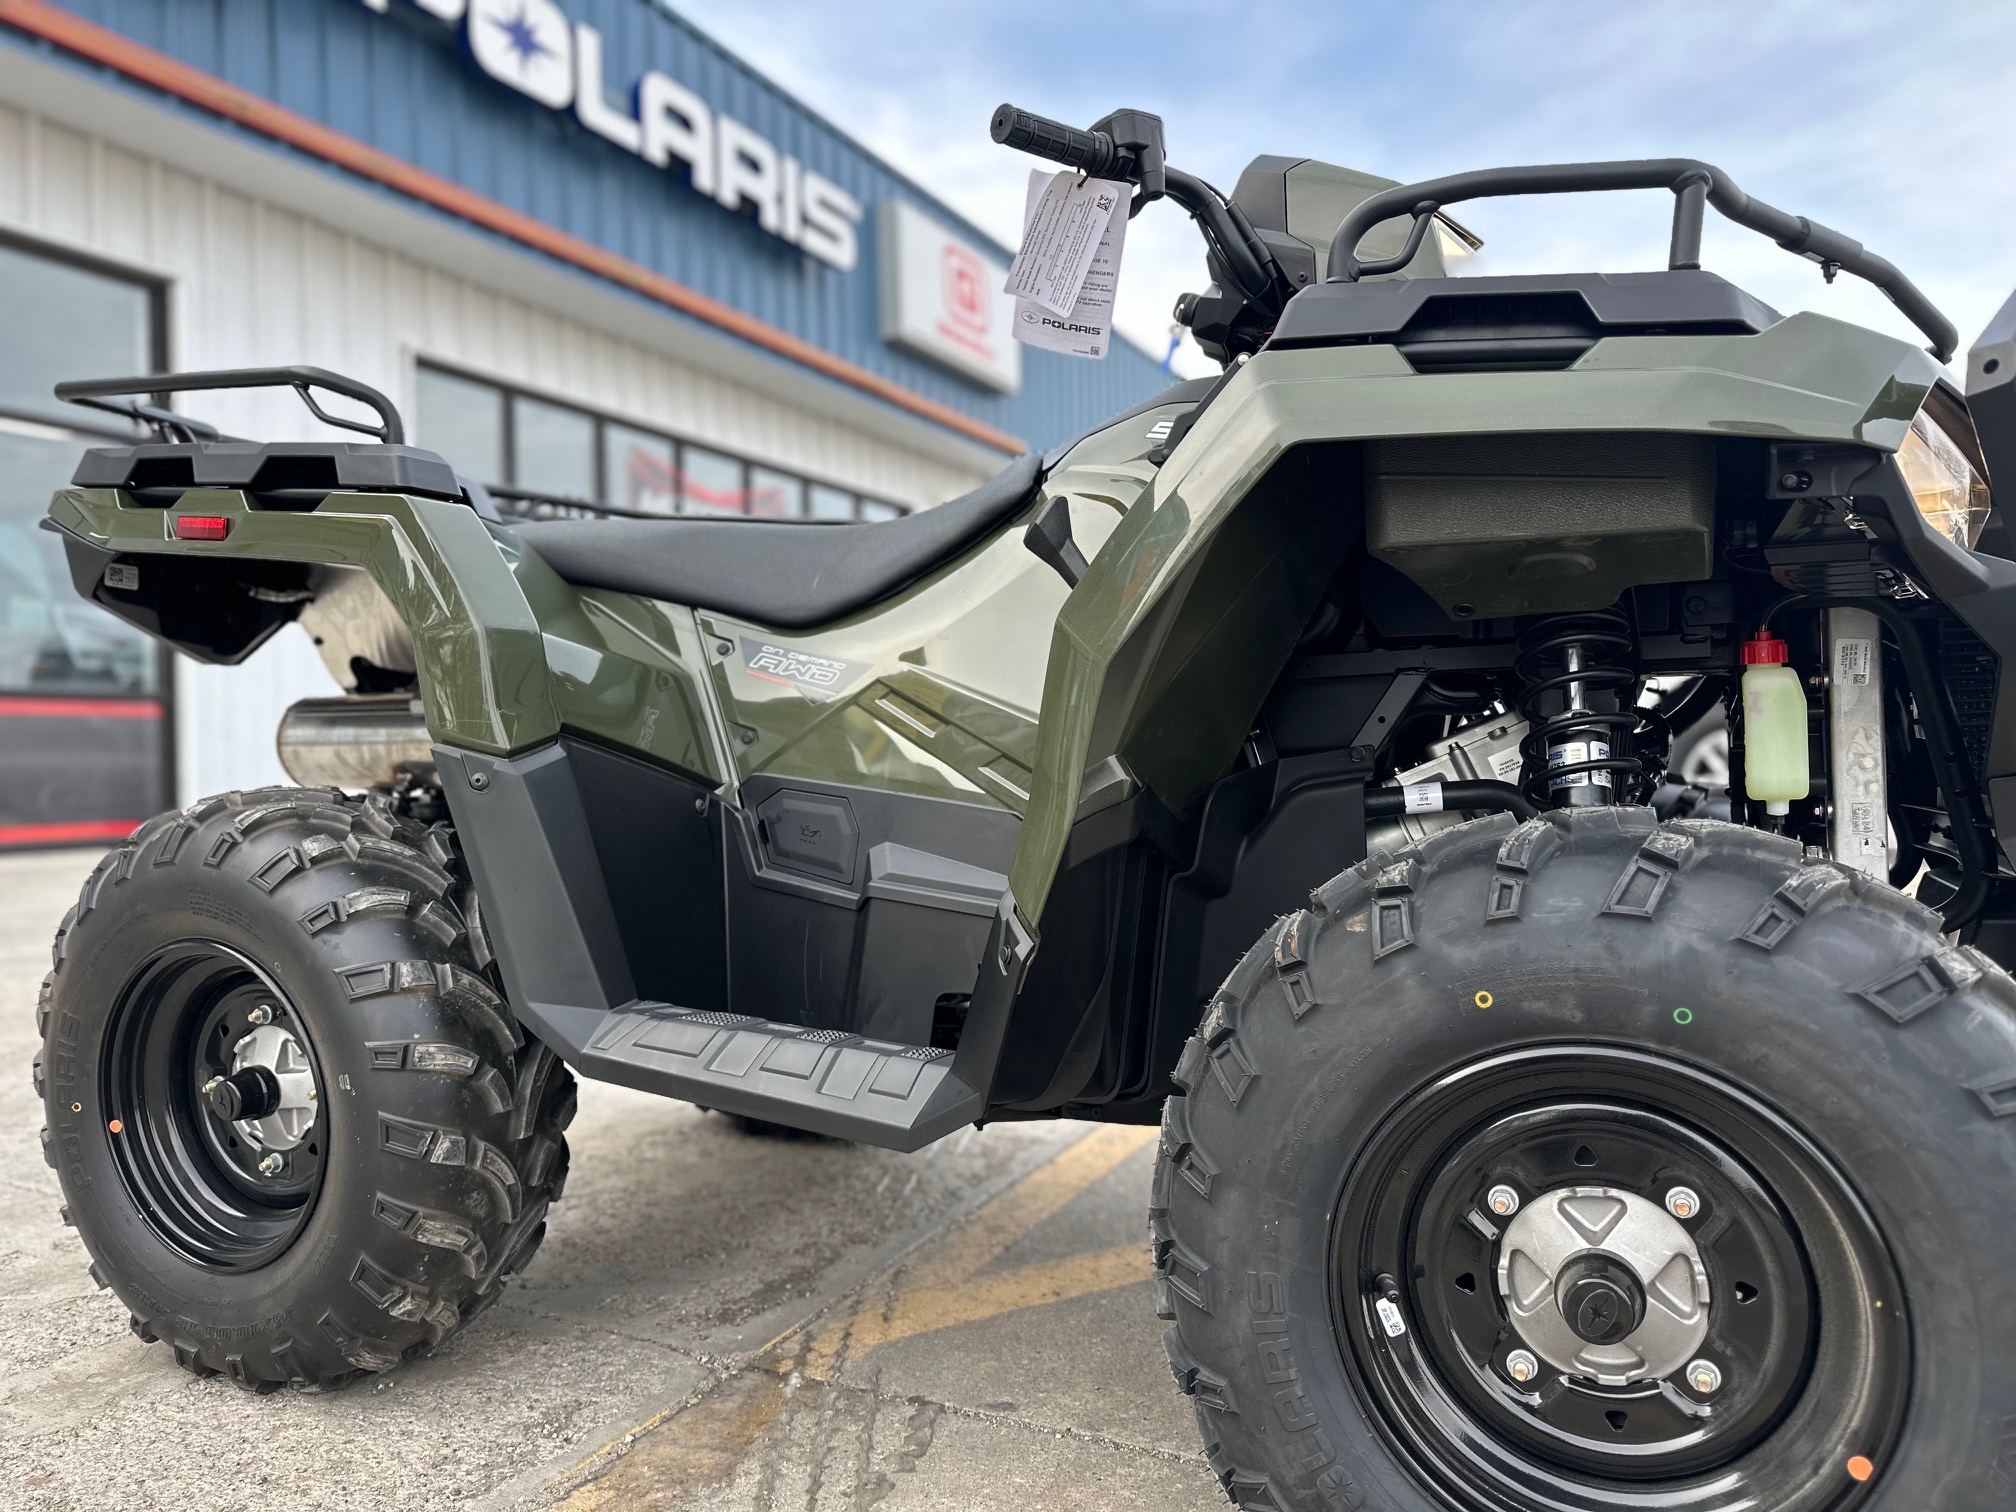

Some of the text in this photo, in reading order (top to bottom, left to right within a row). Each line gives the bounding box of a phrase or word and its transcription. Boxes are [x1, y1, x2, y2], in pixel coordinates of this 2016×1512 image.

[364, 0, 863, 272] OLARIS
[1042, 317, 1101, 336] POLARIS
[749, 652, 841, 686] AWD
[761, 645, 847, 670] ON DEMAND
[1246, 1270, 1364, 1512] OLARIS
